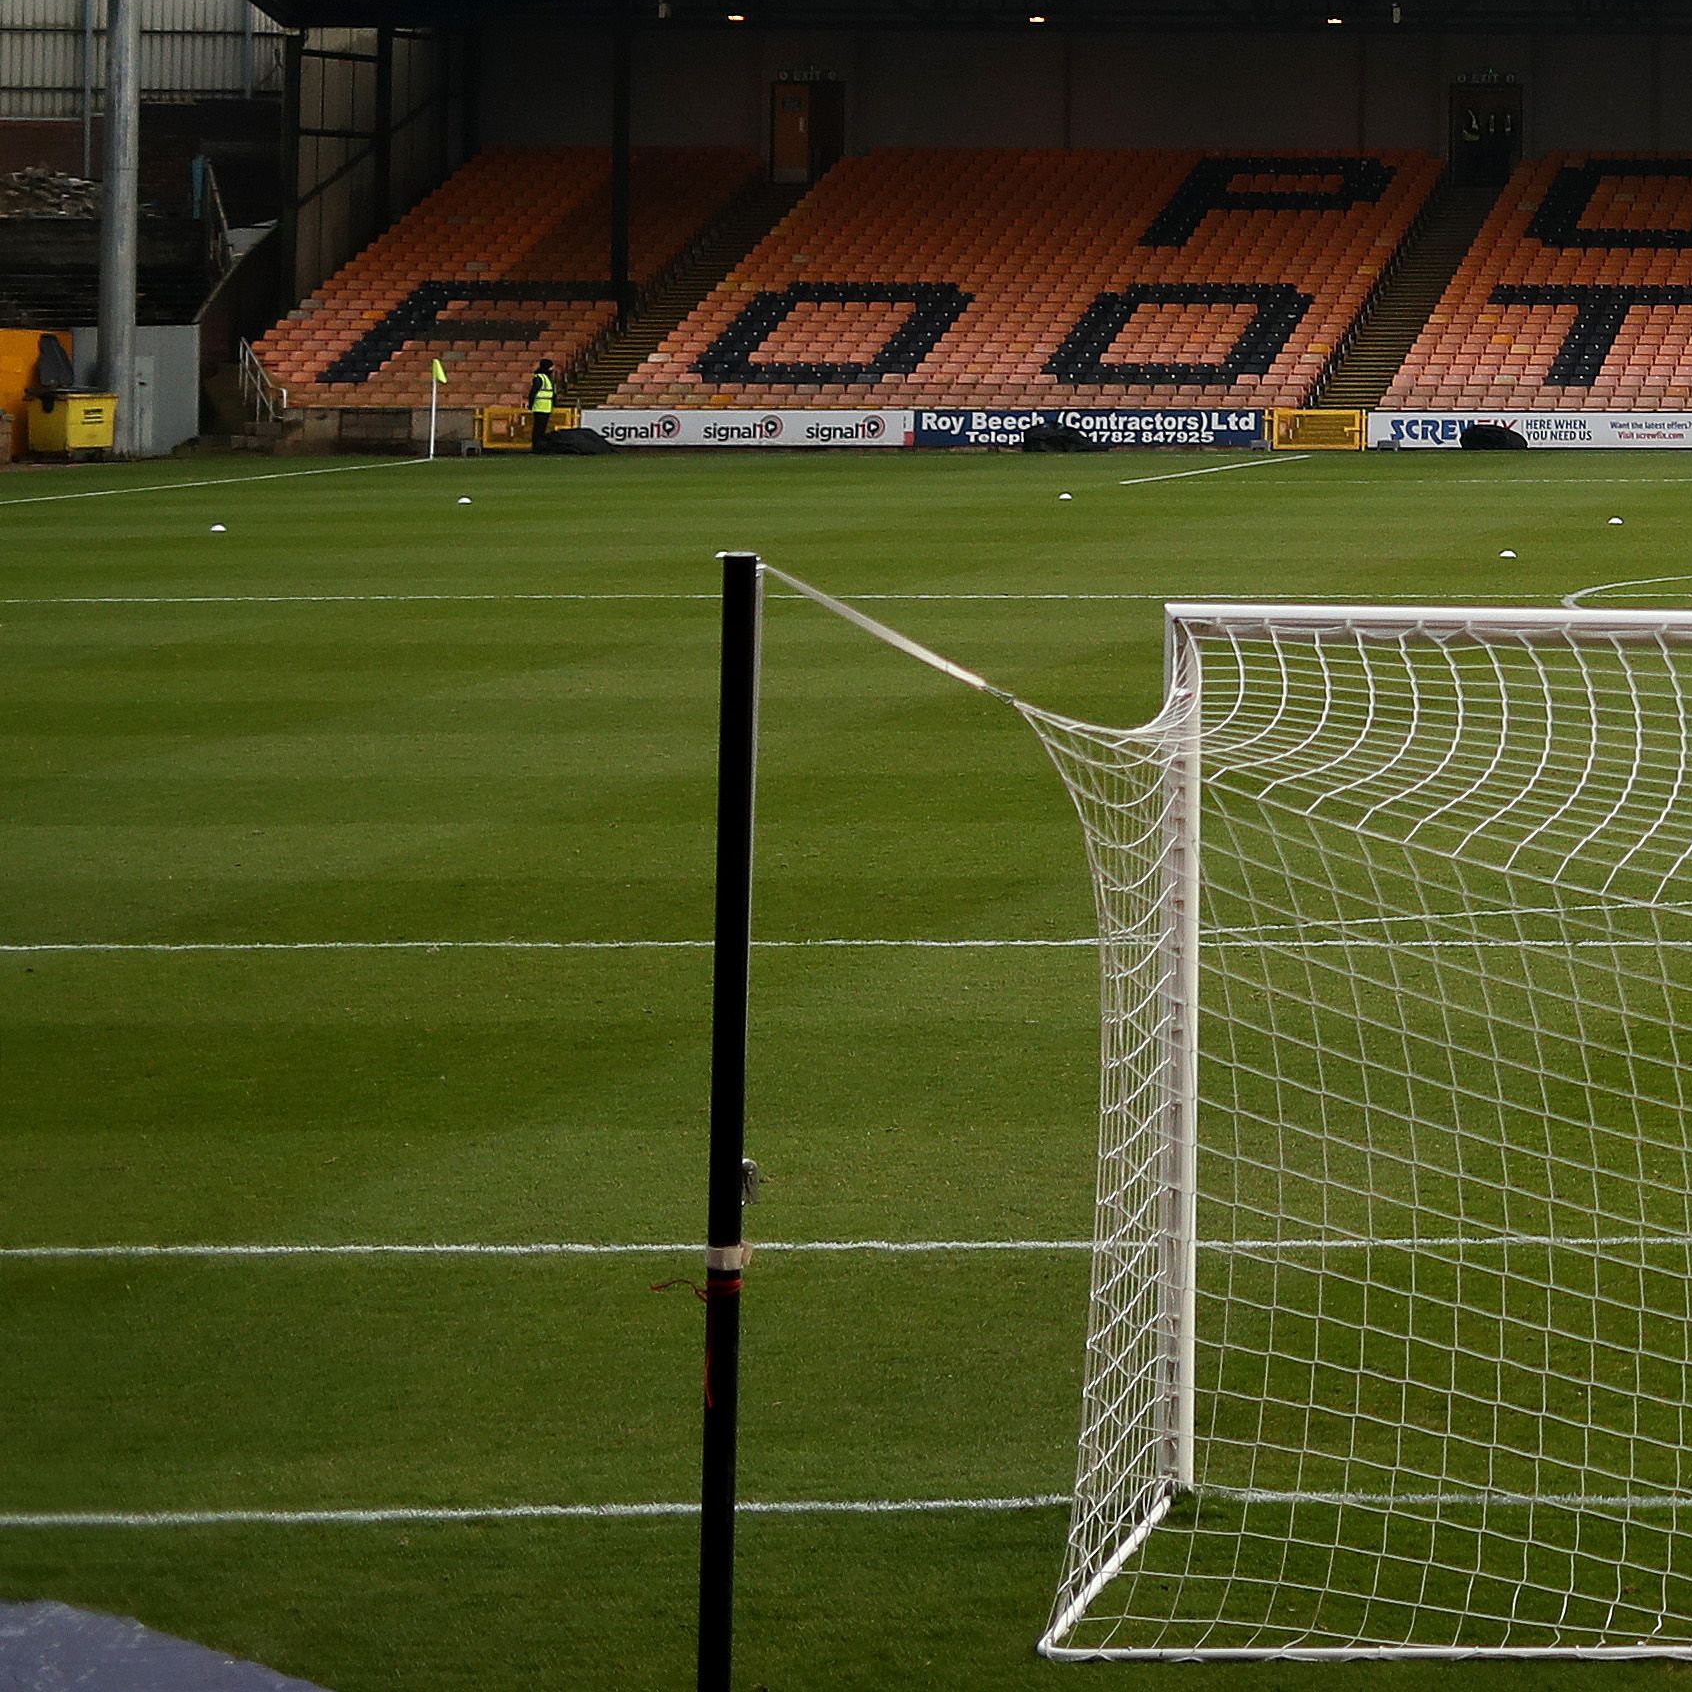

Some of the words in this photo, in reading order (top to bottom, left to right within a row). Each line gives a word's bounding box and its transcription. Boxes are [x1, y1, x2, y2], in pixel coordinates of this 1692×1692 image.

[921, 412, 965, 434] Roy
[971, 412, 1045, 430] Beech
[1211, 412, 1256, 430] Ltd
[1526, 419, 1550, 430] HERE
[1554, 419, 1587, 430] WHEN
[1610, 421, 1630, 429] Want
[1631, 421, 1643, 429] the
[1645, 421, 1665, 429] latest
[1079, 430, 1135, 443] 1782
[1141, 430, 1215, 444] 847925
[1526, 430, 1547, 441] YOU
[1550, 430, 1575, 441] NEED
[1577, 430, 1592, 441] US
[1618, 431, 1634, 439] Visit
